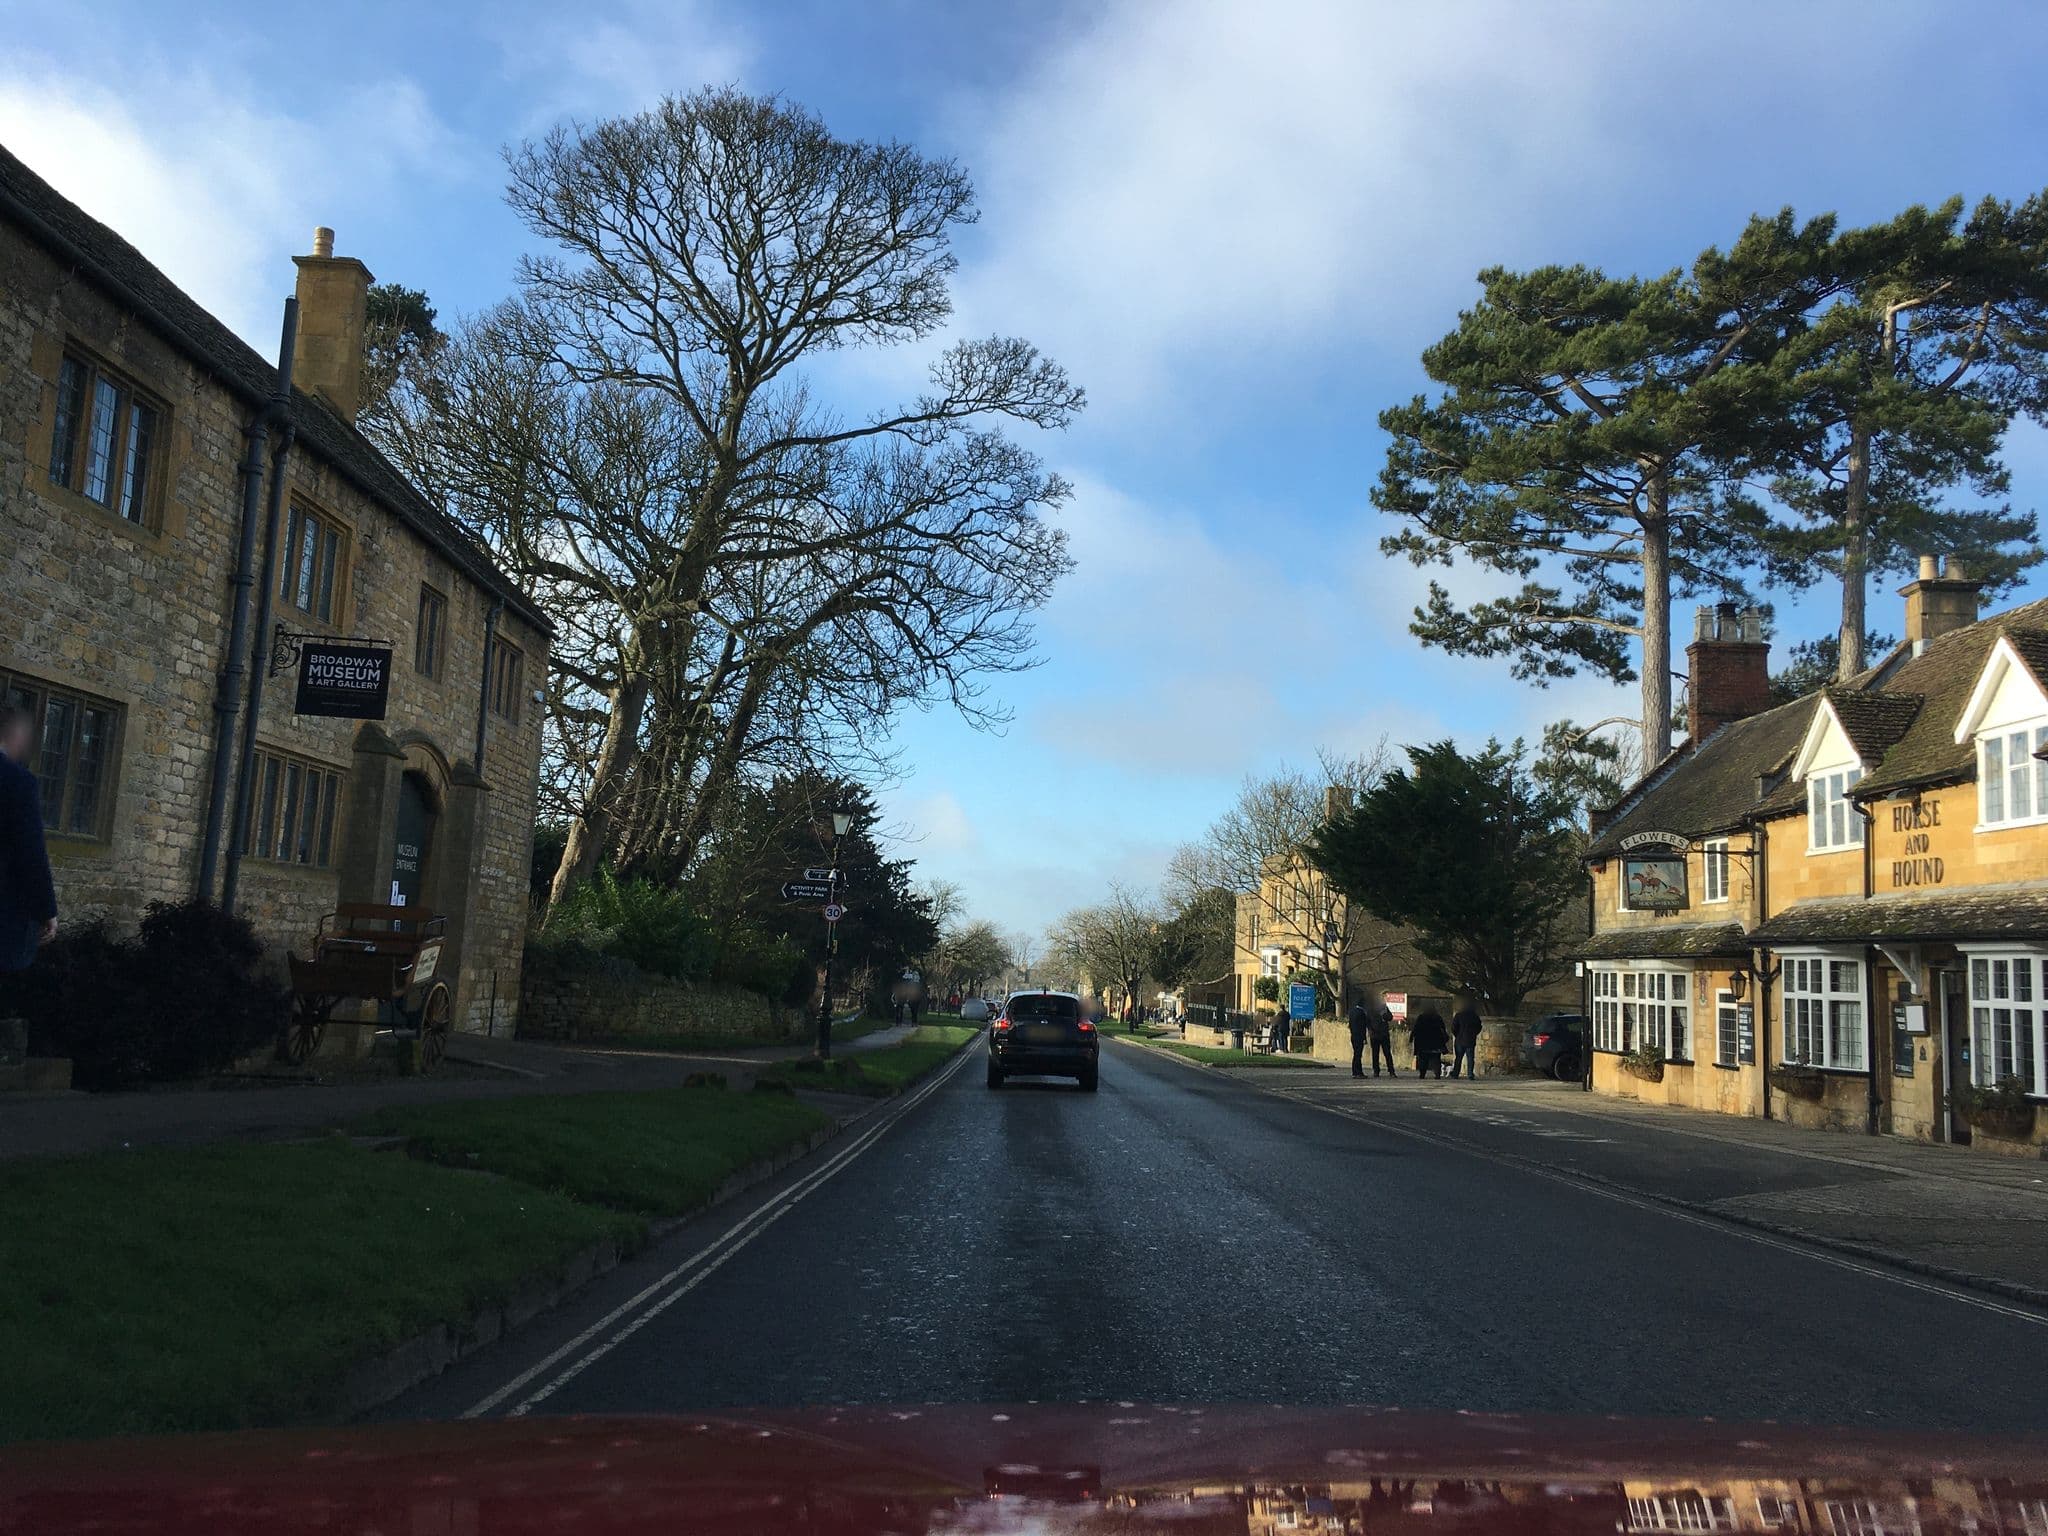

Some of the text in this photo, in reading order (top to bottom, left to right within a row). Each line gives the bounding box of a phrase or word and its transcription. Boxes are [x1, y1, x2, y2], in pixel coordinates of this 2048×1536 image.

[310, 654, 382, 668] BROADWAY
[308, 664, 381, 681] MUSEUM
[316, 678, 336, 687] ART
[337, 680, 380, 690] GALLERY
[1893, 800, 1942, 832] HORSE
[1624, 832, 1686, 848] FLOWERS
[1904, 833, 1930, 856] AND
[398, 843, 418, 857] MUSEUM
[1892, 857, 1945, 888] HOUND
[826, 908, 840, 918] 30
